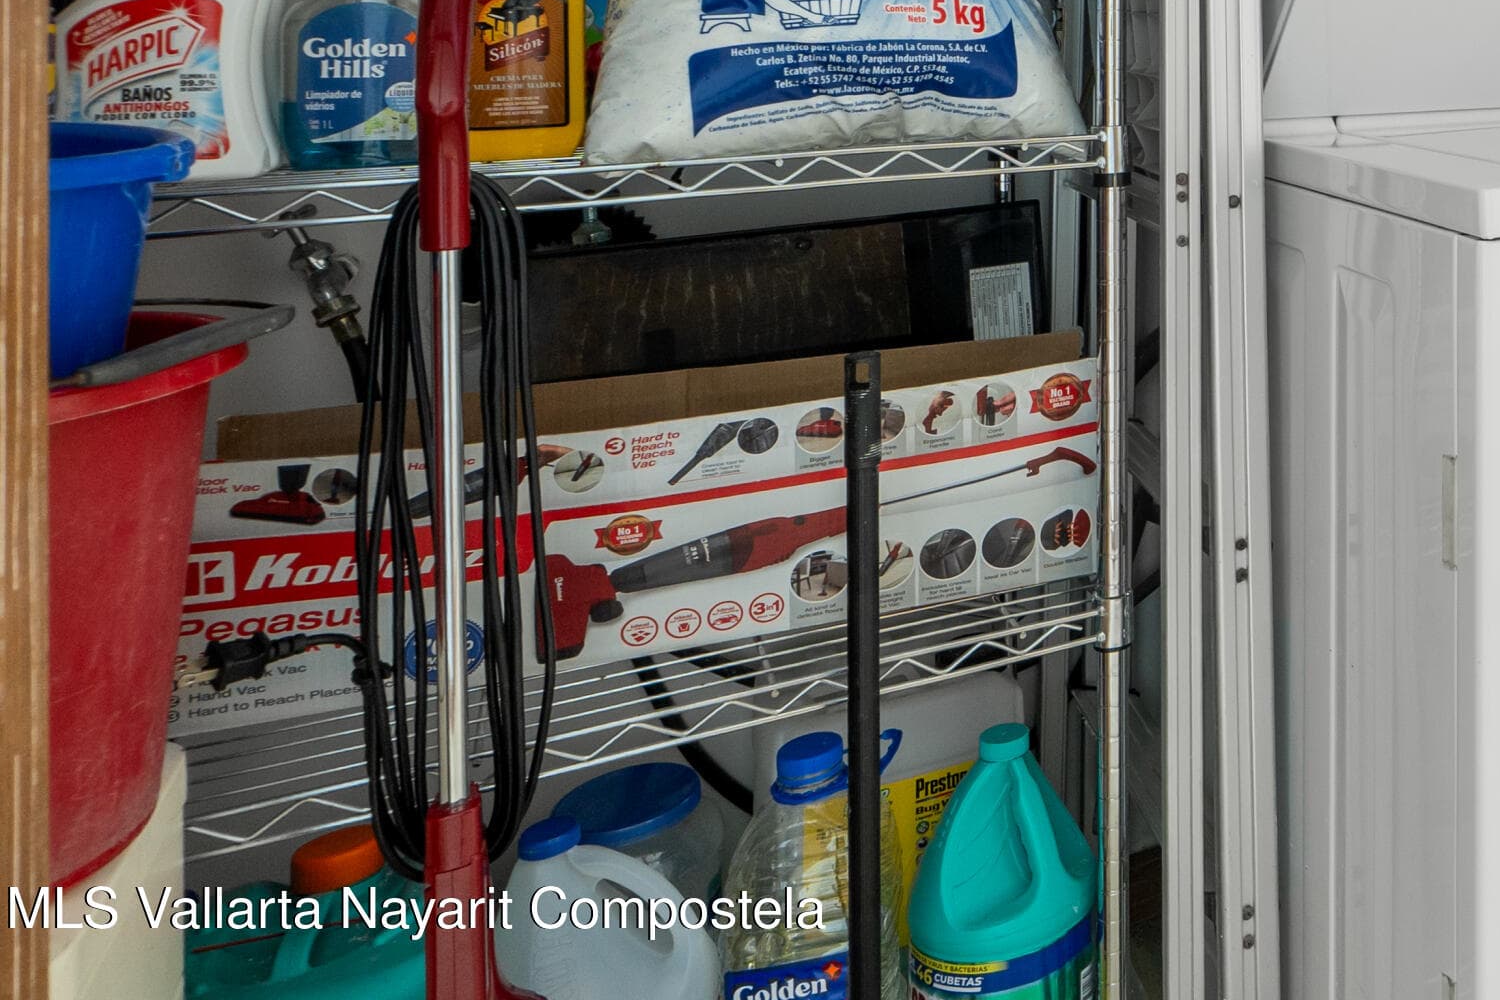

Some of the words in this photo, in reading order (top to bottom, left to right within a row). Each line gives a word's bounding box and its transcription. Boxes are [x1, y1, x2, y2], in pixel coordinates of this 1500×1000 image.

[885, 4, 926, 14] Contenido
[908, 14, 926, 23] Neto
[303, 37, 406, 58] Golden
[489, 37, 541, 62] Silicón
[731, 47, 760, 57] Hecho
[762, 46, 774, 54] en
[777, 44, 809, 53] México
[811, 44, 829, 53] por:
[866, 43, 877, 51] de
[878, 42, 904, 51] Jabón
[905, 42, 916, 51] La
[917, 42, 947, 52] Corona,
[949, 43, 962, 52] S.A.
[964, 44, 974, 52] de
[974, 44, 987, 53] C.V.
[87, 25, 180, 88] HARPIC
[756, 56, 785, 66] Carlos
[787, 55, 796, 64] B.
[798, 54, 827, 63] Zetina
[829, 54, 844, 62] No.
[846, 54, 860, 64] 80,
[862, 54, 893, 65] Parque
[895, 53, 936, 63] Industrial
[937, 54, 970, 64] Xalostoc,
[320, 59, 385, 78] Hills
[783, 65, 825, 77] Ecatepec,
[827, 64, 857, 73] Estado
[859, 65, 870, 74] de
[872, 64, 904, 74] México,
[906, 65, 920, 73] C.P.
[775, 80, 799, 89] Tels.:
[801, 77, 818, 86] +52
[820, 76, 830, 84] 55
[832, 74, 853, 82] 5747
[855, 75, 877, 85] 4545
[885, 77, 900, 85] +52
[902, 75, 913, 83] 55
[934, 74, 955, 84] 4545
[121, 84, 172, 102] BAÑOS
[305, 90, 349, 100] Limpiador
[350, 90, 362, 99] de
[103, 101, 190, 113] ANTIHONGOS
[305, 102, 335, 111] vidrios
[94, 112, 130, 121] PODER
[136, 112, 158, 120] CON
[161, 111, 196, 119] CLORO
[631, 433, 663, 445] Hard
[667, 431, 680, 439] to
[632, 440, 672, 453] Reach
[632, 448, 675, 461] Places
[632, 460, 656, 469] Vac
[232, 484, 261, 493] Vac
[617, 527, 631, 536] No
[244, 550, 484, 591] Kobez
[178, 606, 361, 641] Pegasus
[277, 665, 306, 674] Vac
[189, 689, 232, 702] Hand
[237, 685, 266, 695] Vac
[188, 704, 229, 718] Hard
[234, 702, 249, 711] to
[254, 693, 304, 708] Reach
[309, 686, 361, 700] Places
[916, 803, 940, 815] Bug
[917, 965, 933, 985] 46
[934, 973, 984, 987] CUBETAS
[732, 977, 828, 1000] Golden
